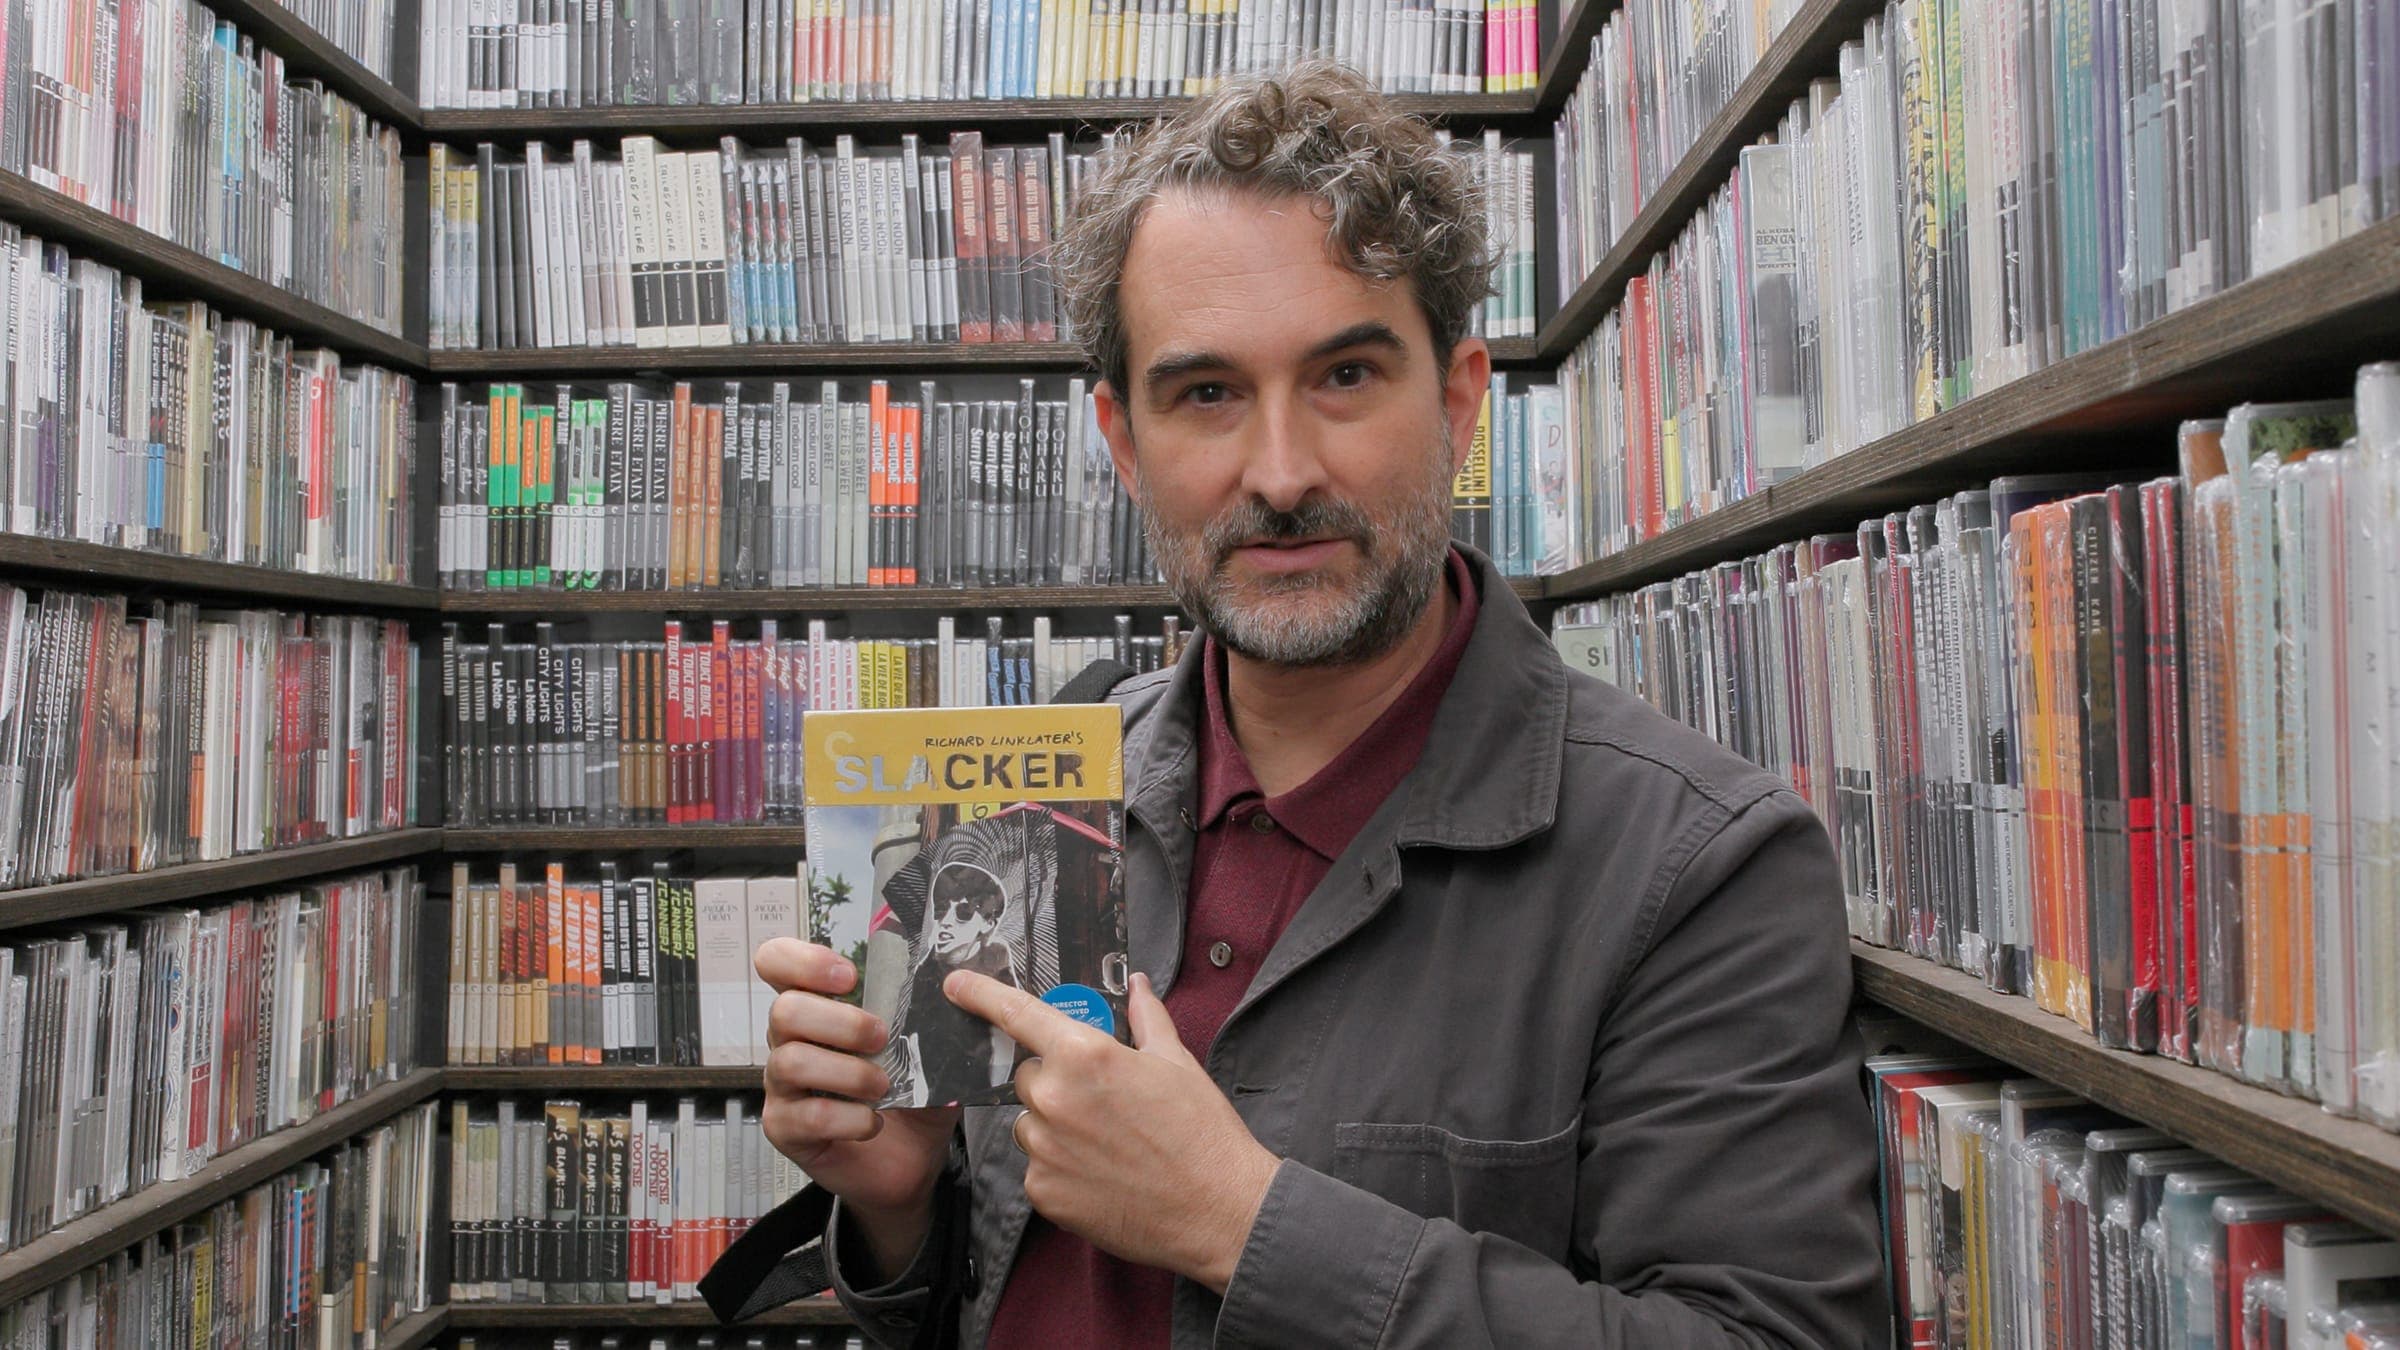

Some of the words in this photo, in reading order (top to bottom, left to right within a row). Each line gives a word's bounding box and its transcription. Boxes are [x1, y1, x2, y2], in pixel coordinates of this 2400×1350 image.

[626, 149, 638, 201] TRILOGY
[960, 155, 972, 172] THE
[1024, 161, 1037, 178] THE
[838, 158, 850, 206] PURPLE
[856, 164, 868, 212] PURPLE
[873, 168, 886, 216] PURPLE
[890, 168, 902, 217] PURPLE
[632, 206, 640, 221] OF
[842, 212, 853, 246] NOON
[961, 200, 976, 236] TRILOGY
[1026, 206, 1041, 242] TRILOGY
[634, 226, 644, 254] LIFE
[860, 218, 870, 250] NOON
[876, 222, 886, 256] NOON
[893, 222, 904, 256] NOON
[1756, 236, 1778, 245] BEN
[558, 394, 570, 418] REPO
[775, 394, 786, 439] medium
[824, 392, 834, 414] LIFE
[556, 422, 569, 444] MAN
[611, 396, 624, 446] PIERRE
[632, 403, 645, 453] PIERRE
[654, 403, 667, 454] PIERRE
[808, 412, 818, 460] medium
[824, 418, 834, 428] IS
[840, 418, 850, 440] LIFE
[856, 416, 865, 438] LIFE
[724, 425, 737, 458] YUMA
[775, 442, 787, 466] cool
[791, 416, 801, 462] medium
[824, 434, 834, 471] SWEET
[840, 444, 850, 455] IS
[856, 443, 864, 453] IS
[610, 451, 622, 494] ETAIX
[758, 448, 770, 482] YUMA
[808, 462, 820, 486] cool
[1473, 426, 1486, 492] ROSSELLINI
[631, 457, 644, 498] ETAIX
[654, 458, 666, 499] ETAIX
[792, 464, 802, 489] cool
[840, 460, 850, 496] SWEET
[856, 458, 866, 494] SWEET
[2088, 526, 2100, 584] CITIZEN
[2091, 598, 2101, 636] KANE
[539, 647, 549, 676] CITY
[668, 635, 679, 666] TOUKI
[700, 650, 710, 682] TOUKI
[861, 652, 872, 662] LA
[878, 652, 888, 662] LA
[492, 662, 502, 676] La
[554, 659, 564, 688] CITY
[572, 657, 582, 686] CITY
[668, 668, 680, 701] BOUKI
[861, 664, 872, 678] VIE
[878, 664, 888, 678] VIE
[492, 678, 503, 709] Notte
[506, 680, 516, 694] La
[526, 678, 535, 693] La
[585, 671, 599, 720] Frances
[604, 667, 618, 715] Frances
[700, 684, 712, 716] BOUKI
[861, 680, 872, 690] DE
[861, 692, 872, 708] BOH
[878, 680, 888, 690] DE
[878, 692, 888, 708] BOH
[506, 696, 517, 724] Notte
[526, 694, 536, 724] Notte
[539, 680, 549, 722] LIGHTS
[554, 693, 564, 734] LIGHTS
[572, 691, 582, 733] LIGHTS
[585, 722, 599, 742] Ha
[604, 718, 618, 736] Ha
[926, 736, 984, 748] RICHARD
[990, 732, 1083, 746] LINKLATER'S
[835, 752, 1086, 793] SLACKER
[518, 900, 528, 930] RED
[534, 896, 544, 926] RED
[548, 874, 562, 949] JUDEX
[602, 888, 614, 912] HARD
[636, 895, 648, 920] HARD
[603, 914, 614, 940] DAY'S
[657, 878, 668, 955] SCANNERS
[670, 888, 682, 960] SCANNERS
[682, 888, 694, 959] SCANNERS
[535, 928, 545, 972] RIVER
[566, 898, 580, 972] JUDEX
[584, 901, 598, 976] JUDEX
[636, 922, 648, 948] DAY'S
[518, 932, 528, 976] RIVER
[604, 942, 615, 970] NIGHT
[637, 950, 649, 976] NIGHT
[1052, 1000, 1088, 1008] DIRECTOR
[556, 1118, 567, 1144] LES
[586, 1124, 597, 1152] LES
[612, 1124, 624, 1152] LES
[633, 1132, 642, 1187] TOOTSIE
[649, 1142, 658, 1197] TOOTSIE
[658, 1149, 669, 1205] TOOTSIE
